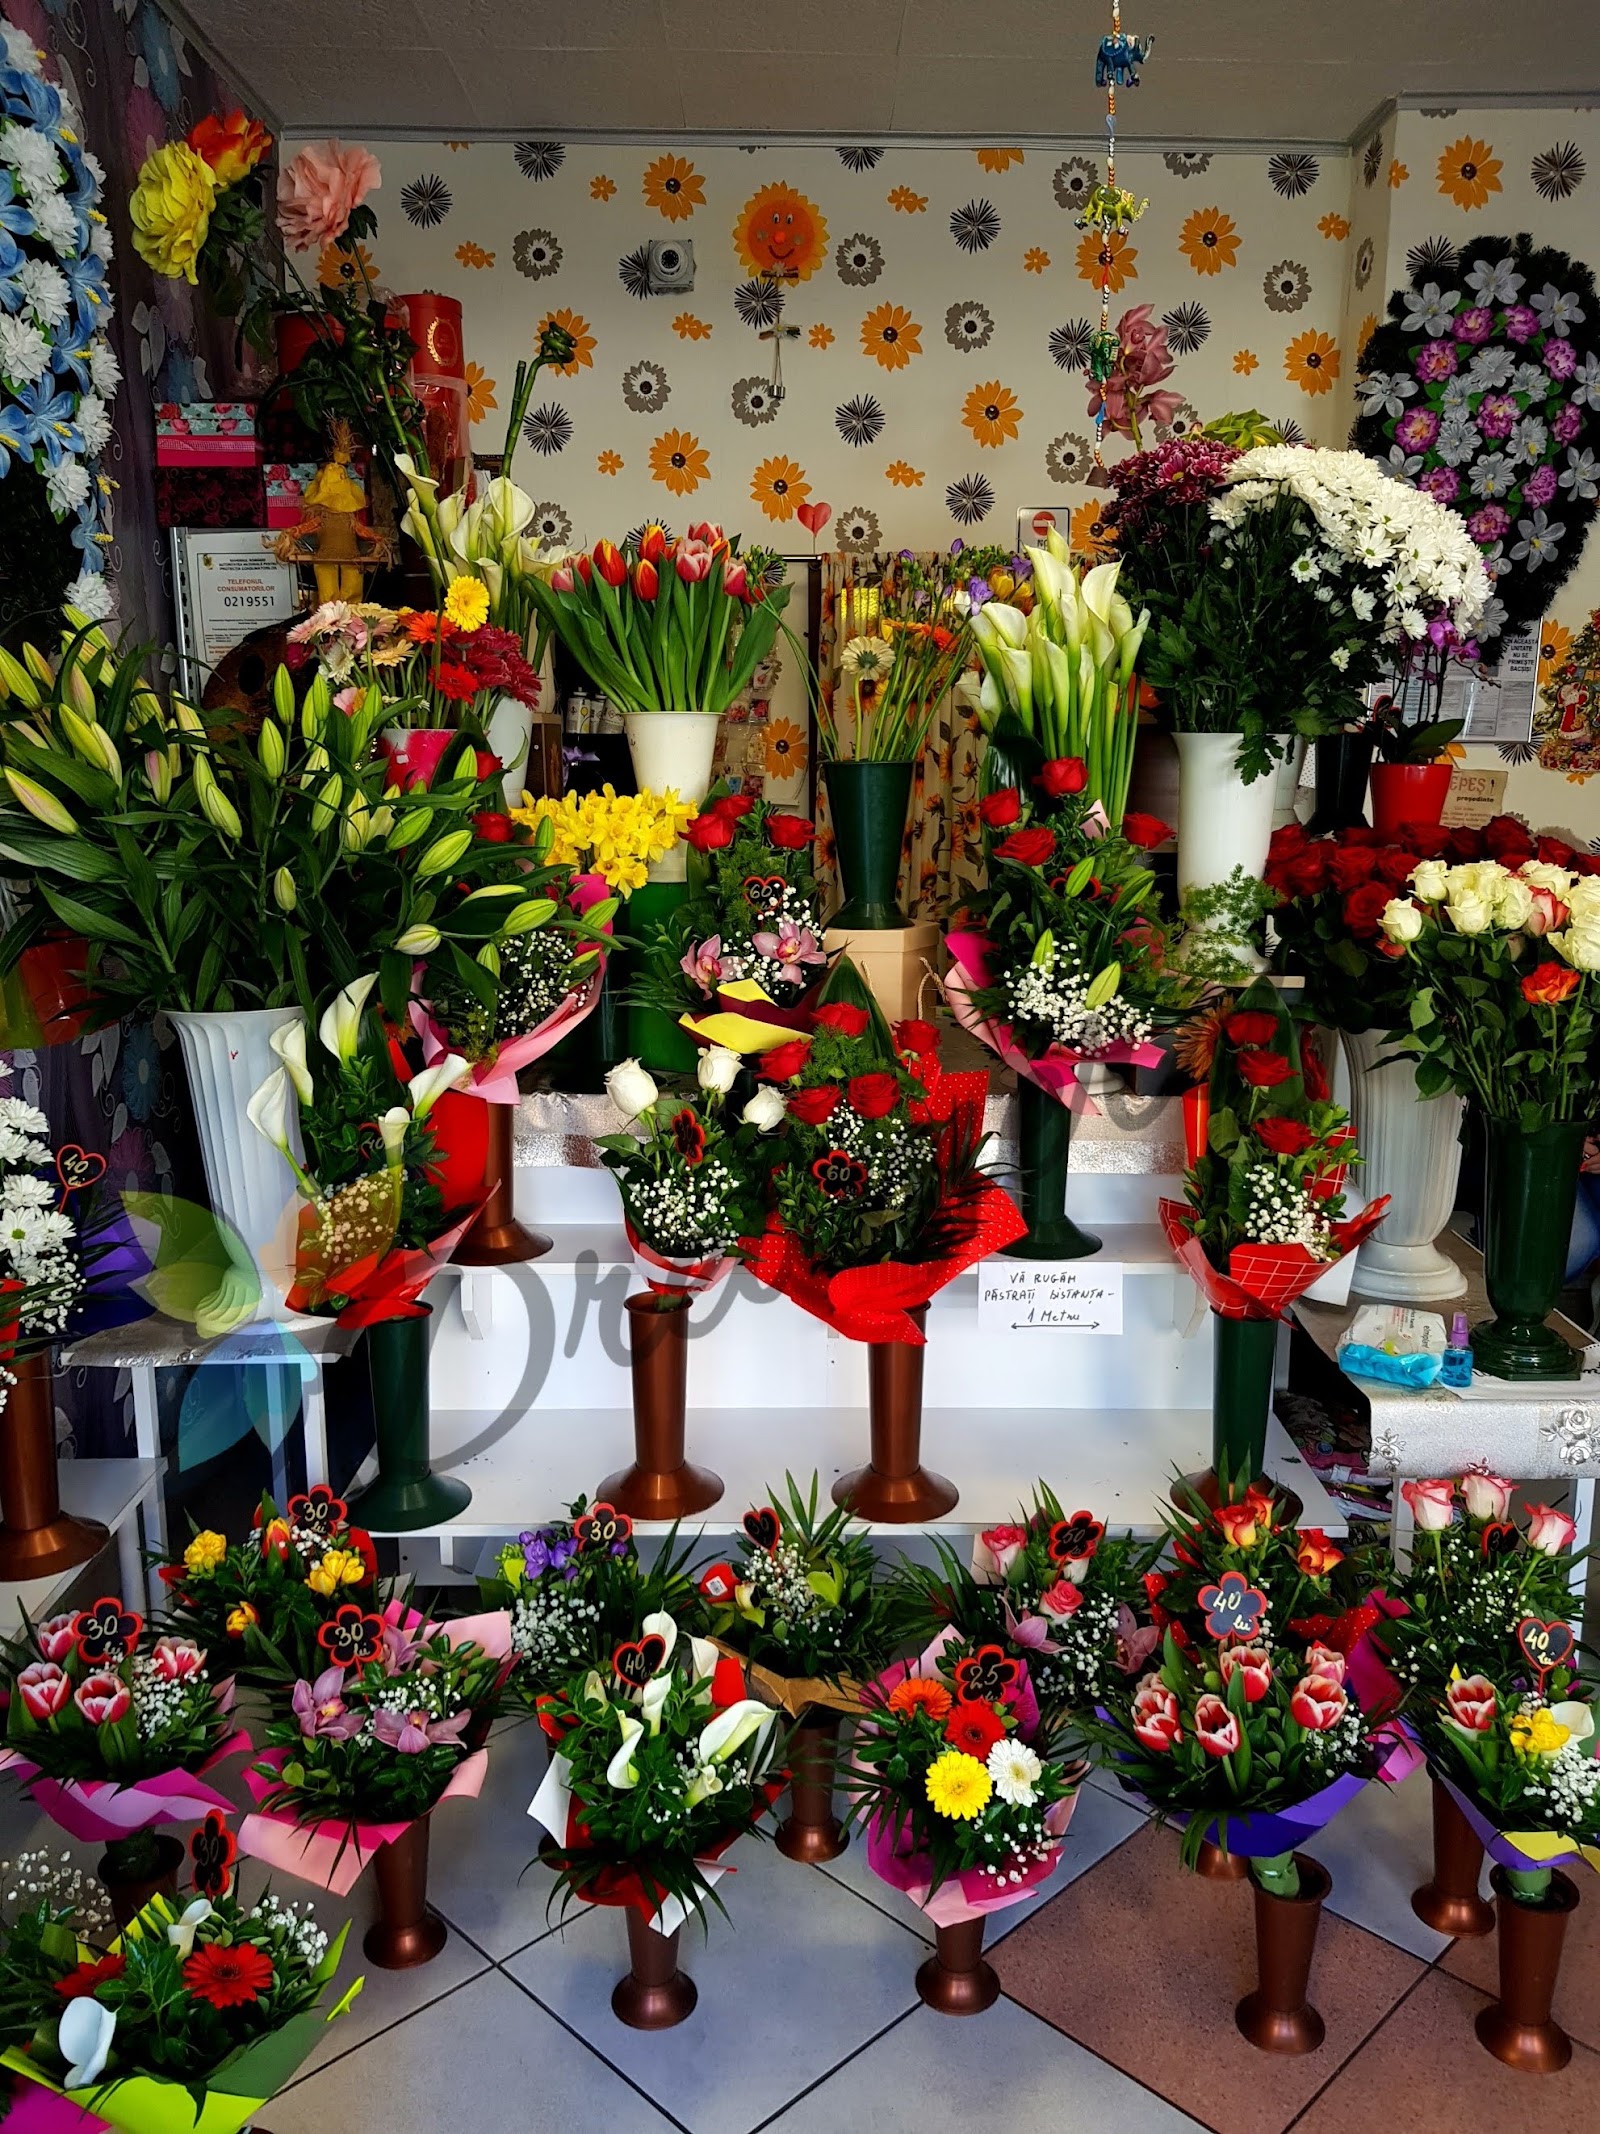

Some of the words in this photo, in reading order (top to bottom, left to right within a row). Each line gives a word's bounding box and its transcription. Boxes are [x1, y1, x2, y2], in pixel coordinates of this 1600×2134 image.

[224, 596, 275, 607] 0219551
[750, 883, 773, 899] 60
[63, 1152, 90, 1174] 40
[826, 1164, 851, 1182] 60
[1010, 1271, 1026, 1284] VĂ
[1027, 1307, 1035, 1323] 1
[303, 1501, 329, 1522] 30
[590, 1520, 617, 1541] 30
[1062, 1527, 1086, 1544] 50
[1212, 1590, 1242, 1613] 40
[86, 1614, 118, 1640] 30
[1232, 1613, 1252, 1632] lei
[334, 1622, 364, 1647] 30
[1524, 1627, 1550, 1650] 40
[624, 1652, 645, 1676] 40
[969, 1663, 1005, 1690] 25
[199, 1836, 220, 1867] 30
